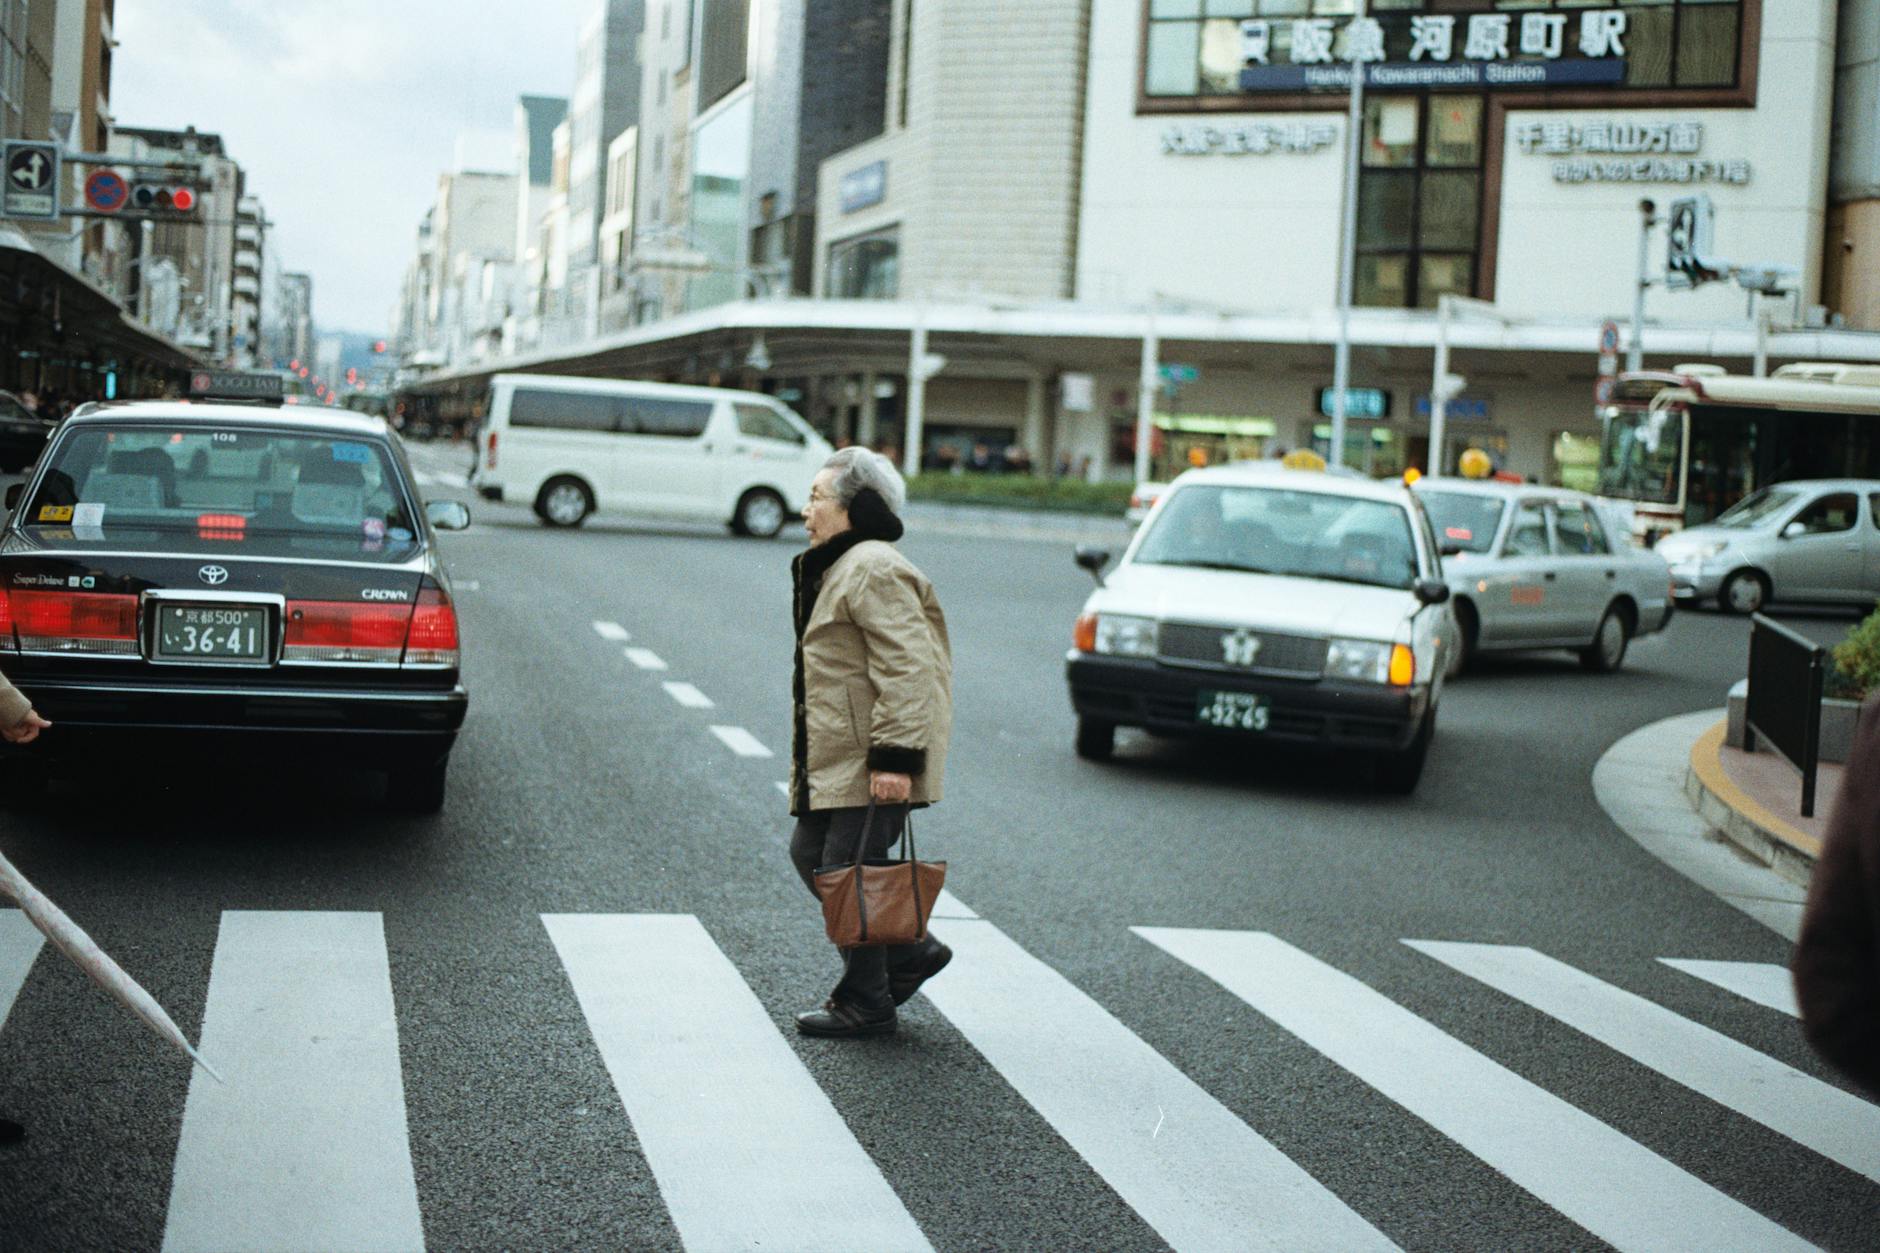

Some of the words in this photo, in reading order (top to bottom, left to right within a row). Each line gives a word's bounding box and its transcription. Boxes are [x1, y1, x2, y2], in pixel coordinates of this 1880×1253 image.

[1369, 64, 1480, 86] Kawaramachi
[1485, 61, 1547, 83] Station
[213, 432, 237, 442] 108
[361, 588, 408, 600] CROWN
[182, 625, 255, 654] 36-41
